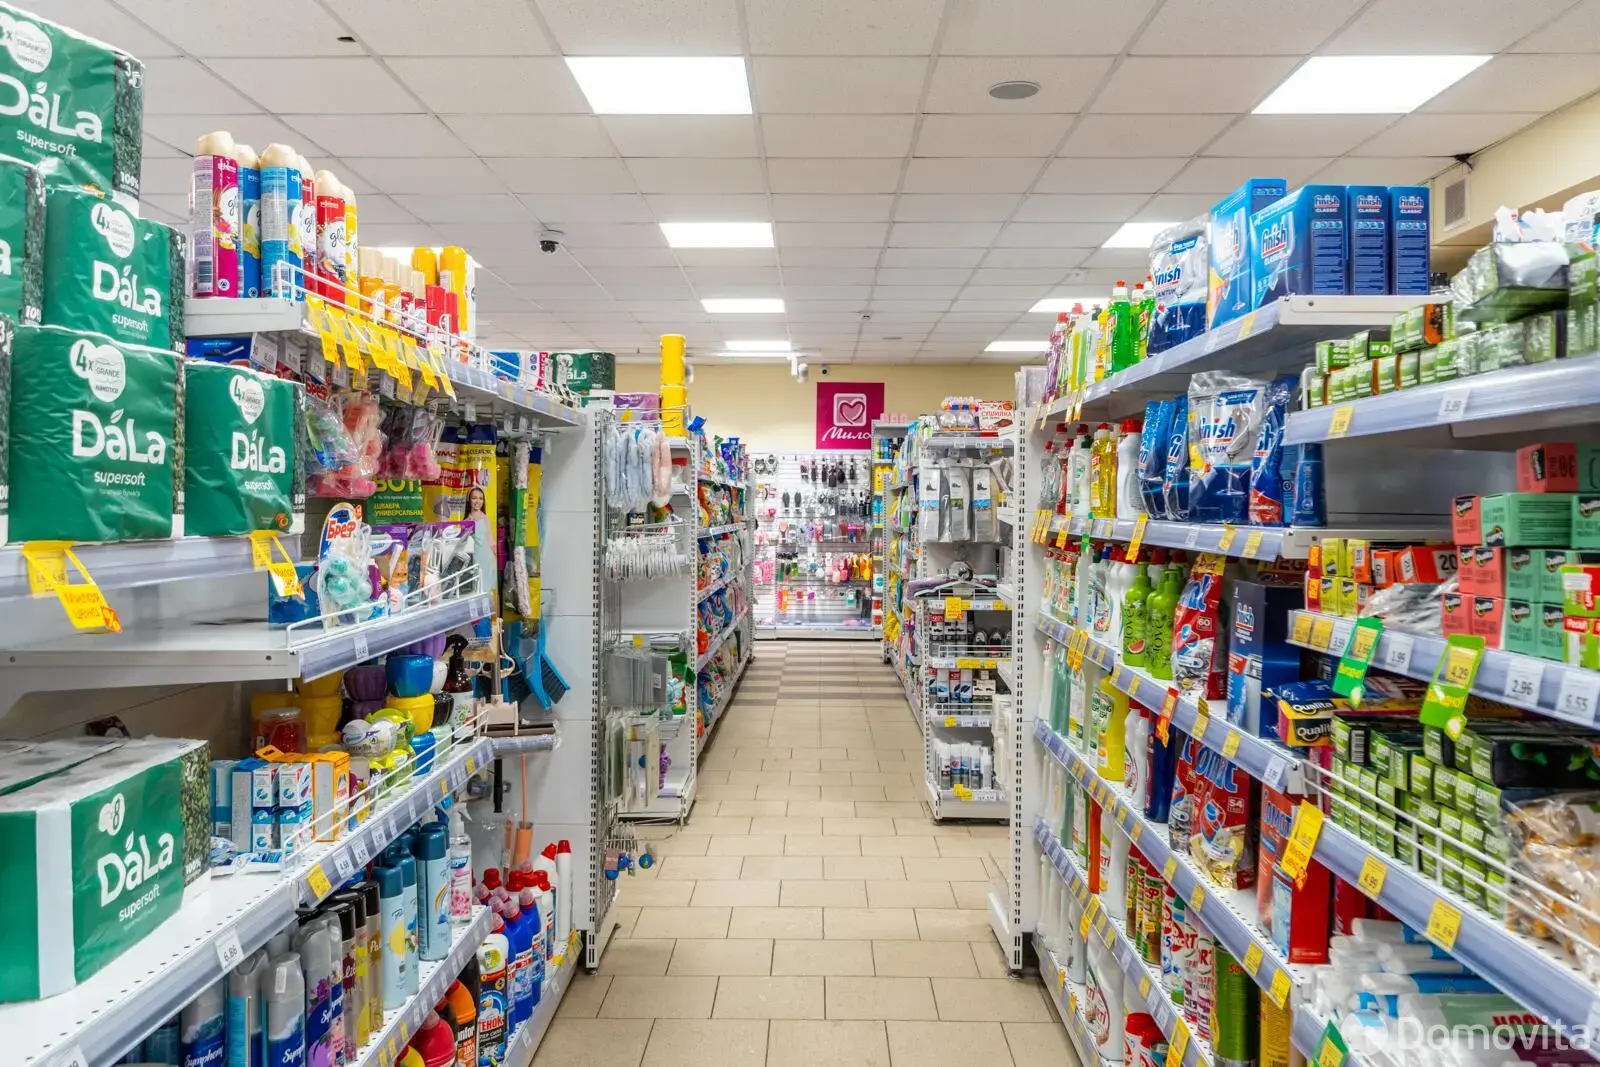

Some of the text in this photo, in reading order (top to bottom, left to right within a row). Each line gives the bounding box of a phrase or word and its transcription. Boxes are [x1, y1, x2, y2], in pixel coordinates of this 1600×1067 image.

[0, 72, 103, 144] DáLa
[16, 129, 77, 156] supersoft
[1262, 224, 1287, 251] finish
[92, 260, 161, 317] DáLa
[76, 343, 87, 372] 4
[95, 366, 121, 378] GRANDE
[566, 368, 587, 380] áLa
[72, 408, 167, 465] DáLa
[231, 429, 286, 473] DáLa
[94, 471, 146, 486] supersoft
[375, 509, 423, 517] УНИВЕРСАЛЬНА
[326, 519, 357, 540] Бреф
[1438, 554, 1457, 571] 20
[1512, 679, 1534, 696] 2.96
[1292, 702, 1333, 713] Qualita
[1297, 723, 1332, 737] Qualit
[1229, 799, 1243, 808] 54
[97, 831, 174, 908] DáLa
[119, 884, 160, 922] supersoft
